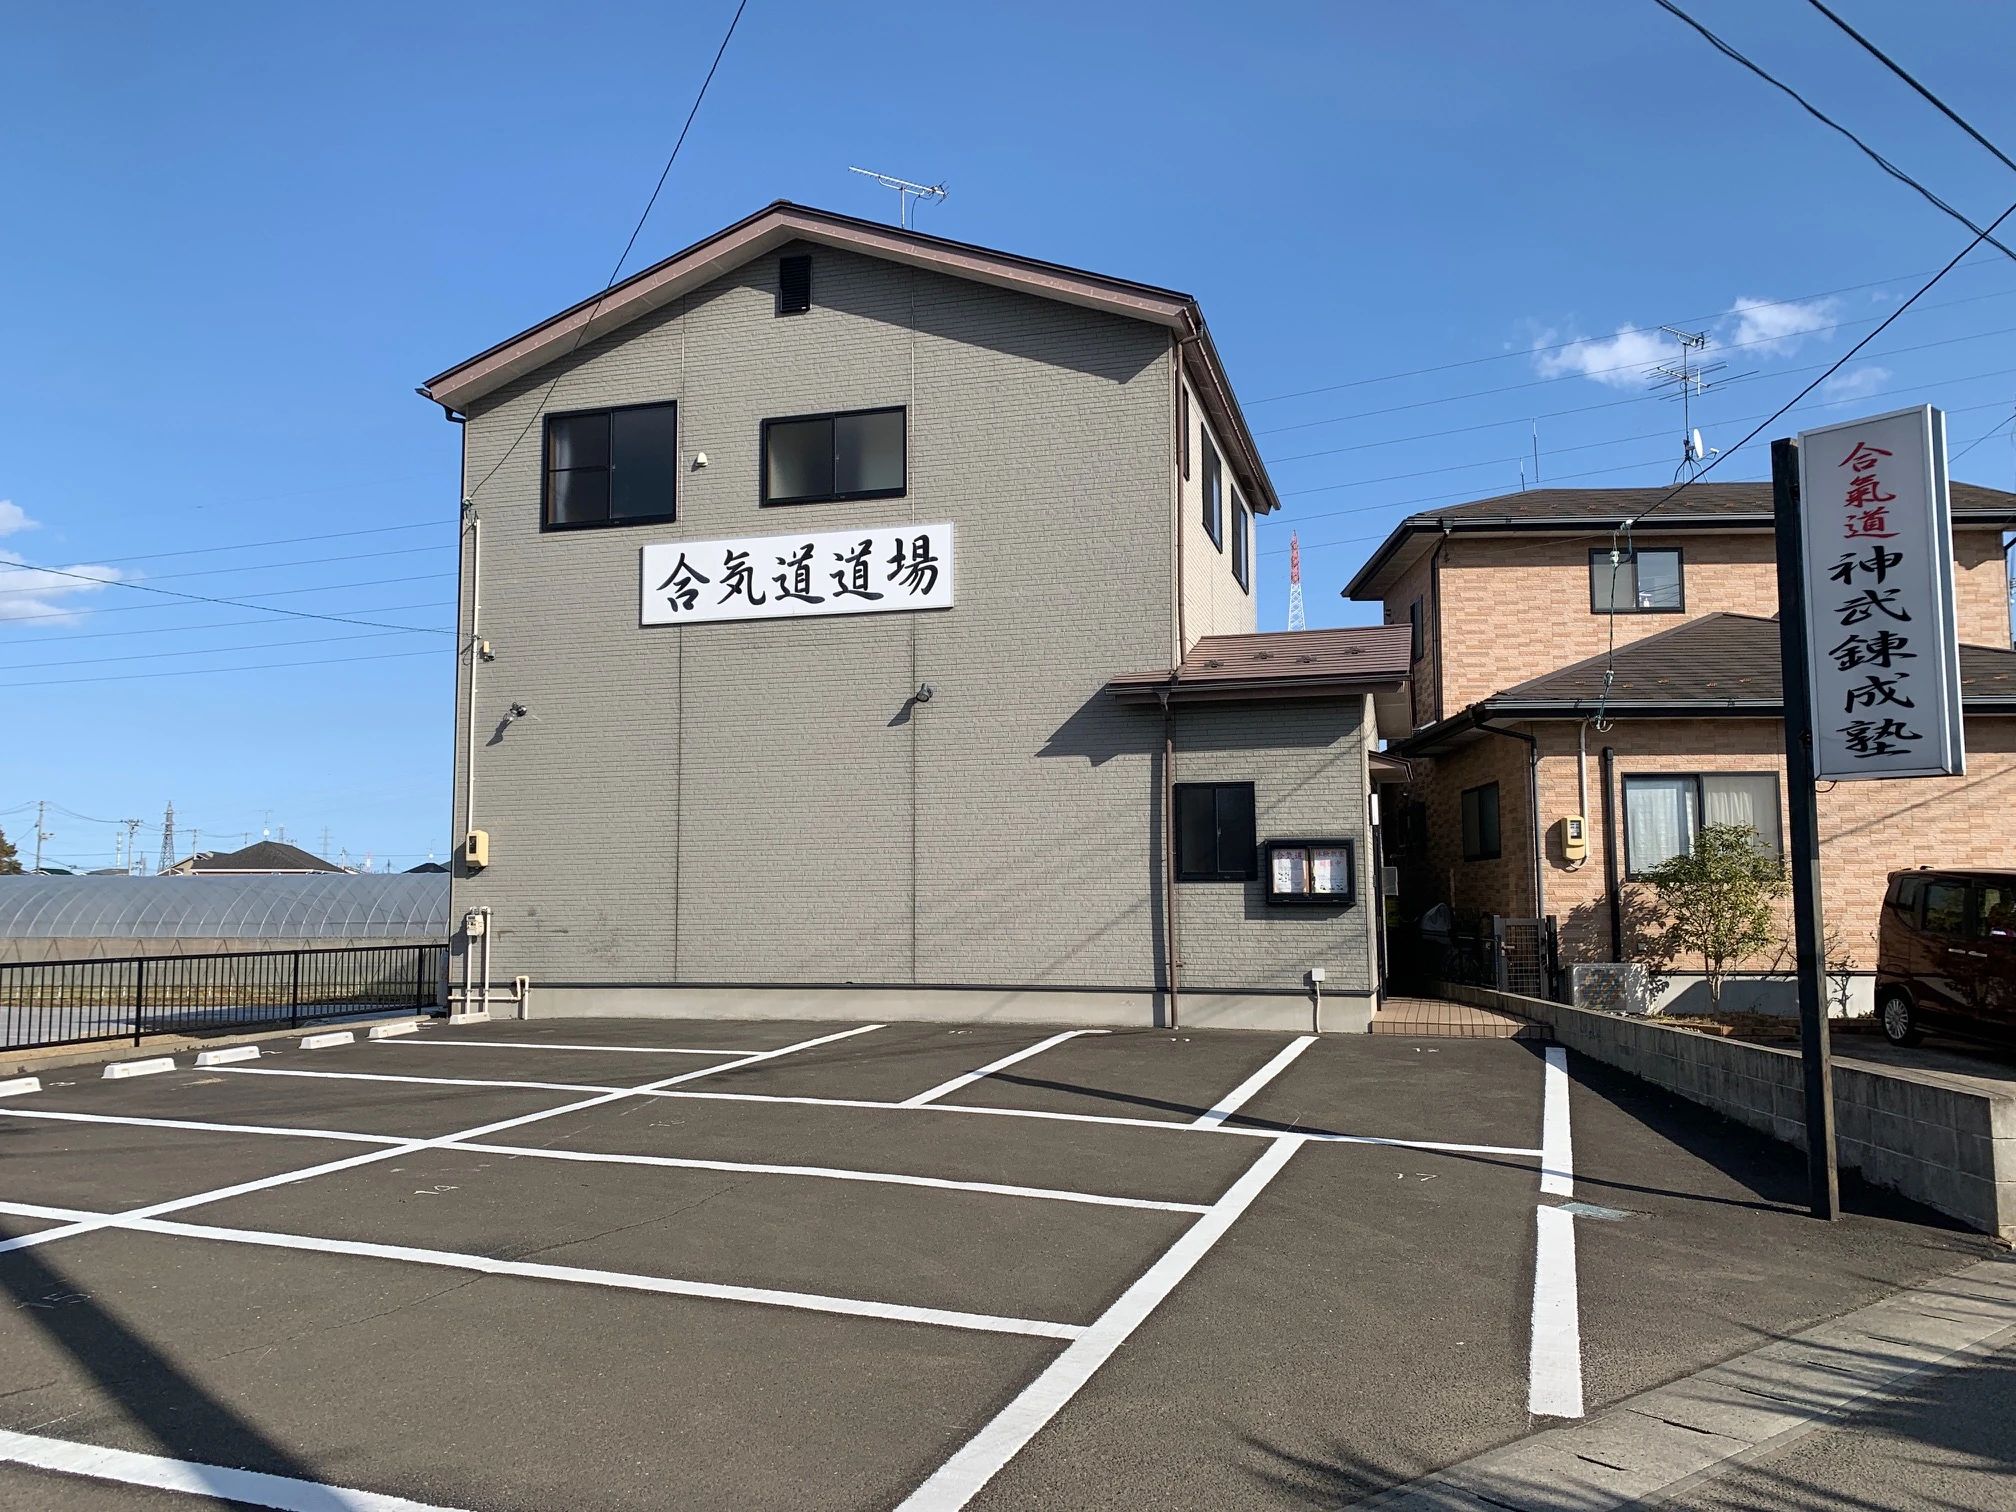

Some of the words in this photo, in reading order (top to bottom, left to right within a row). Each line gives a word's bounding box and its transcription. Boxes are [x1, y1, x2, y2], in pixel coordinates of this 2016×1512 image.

[1837, 441, 1900, 539] 合氣道
[656, 534, 939, 613] 合気道道場
